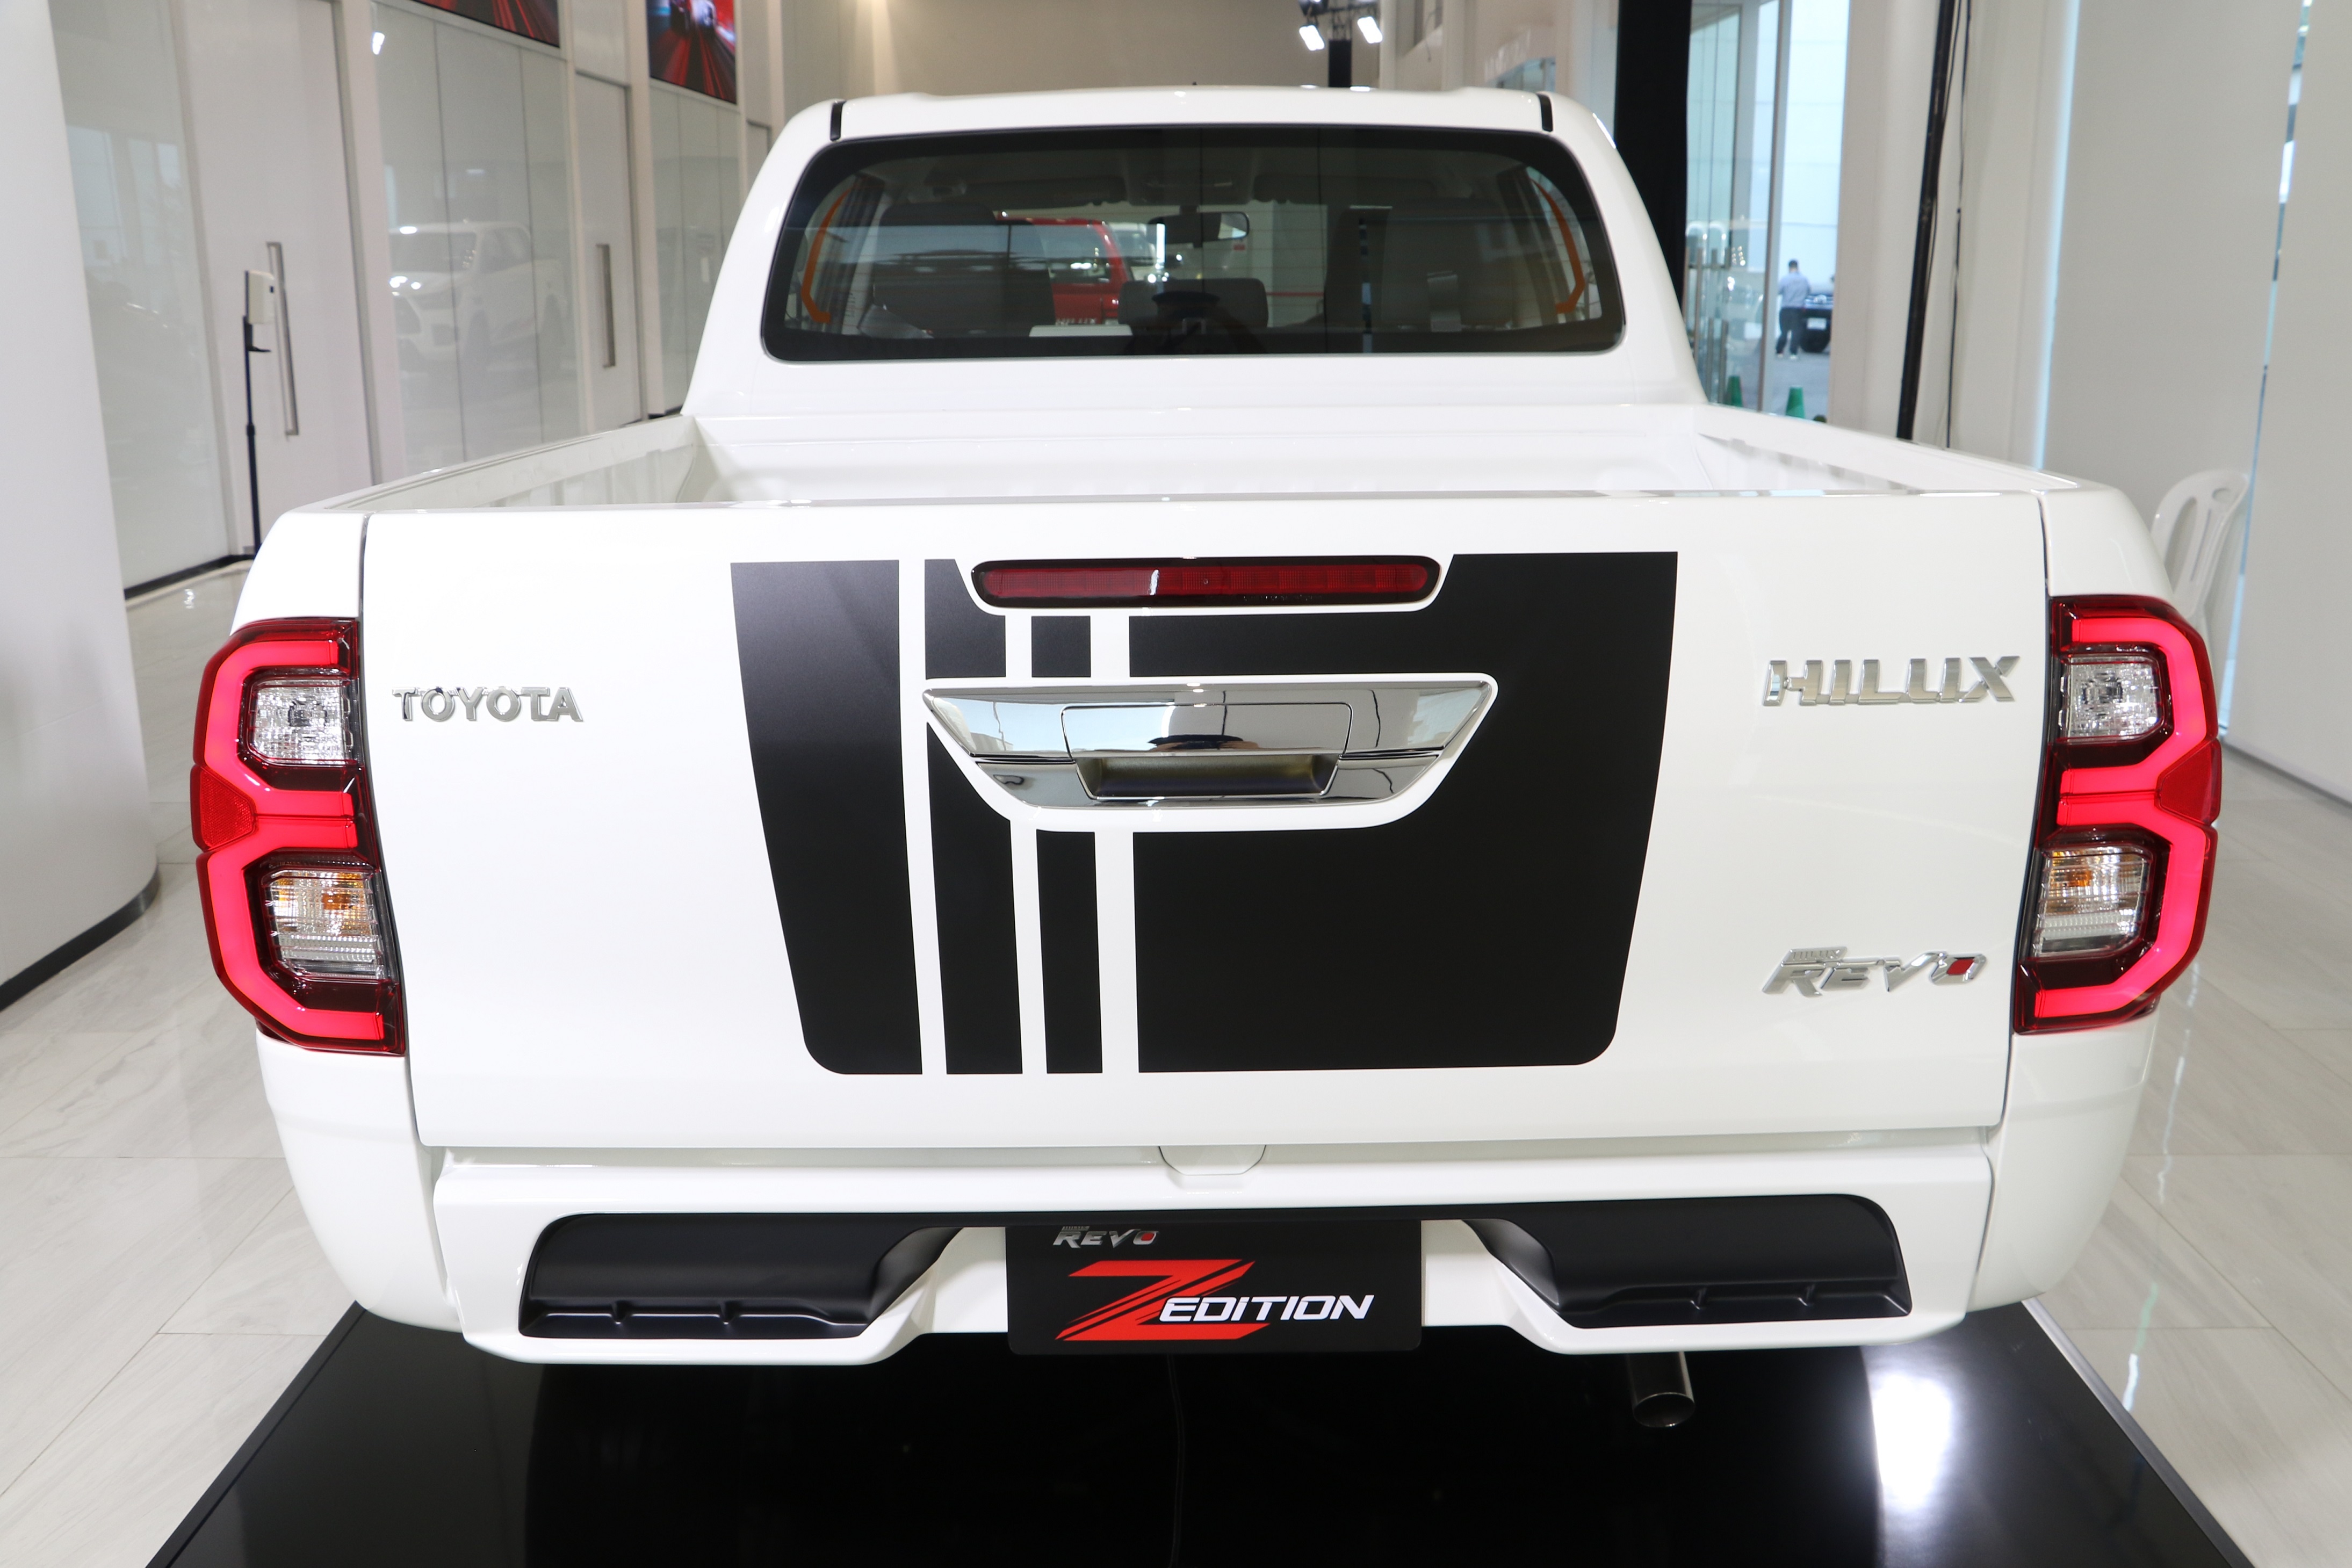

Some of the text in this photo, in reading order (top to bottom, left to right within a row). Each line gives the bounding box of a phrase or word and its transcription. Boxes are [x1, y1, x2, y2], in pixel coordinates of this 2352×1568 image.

[392, 686, 583, 721] TOYOTA
[1763, 656, 2021, 706] HILUX
[1762, 950, 1987, 996] REVO
[1052, 1229, 1159, 1248] REVO
[1055, 1259, 1375, 1341] Z EDITION
